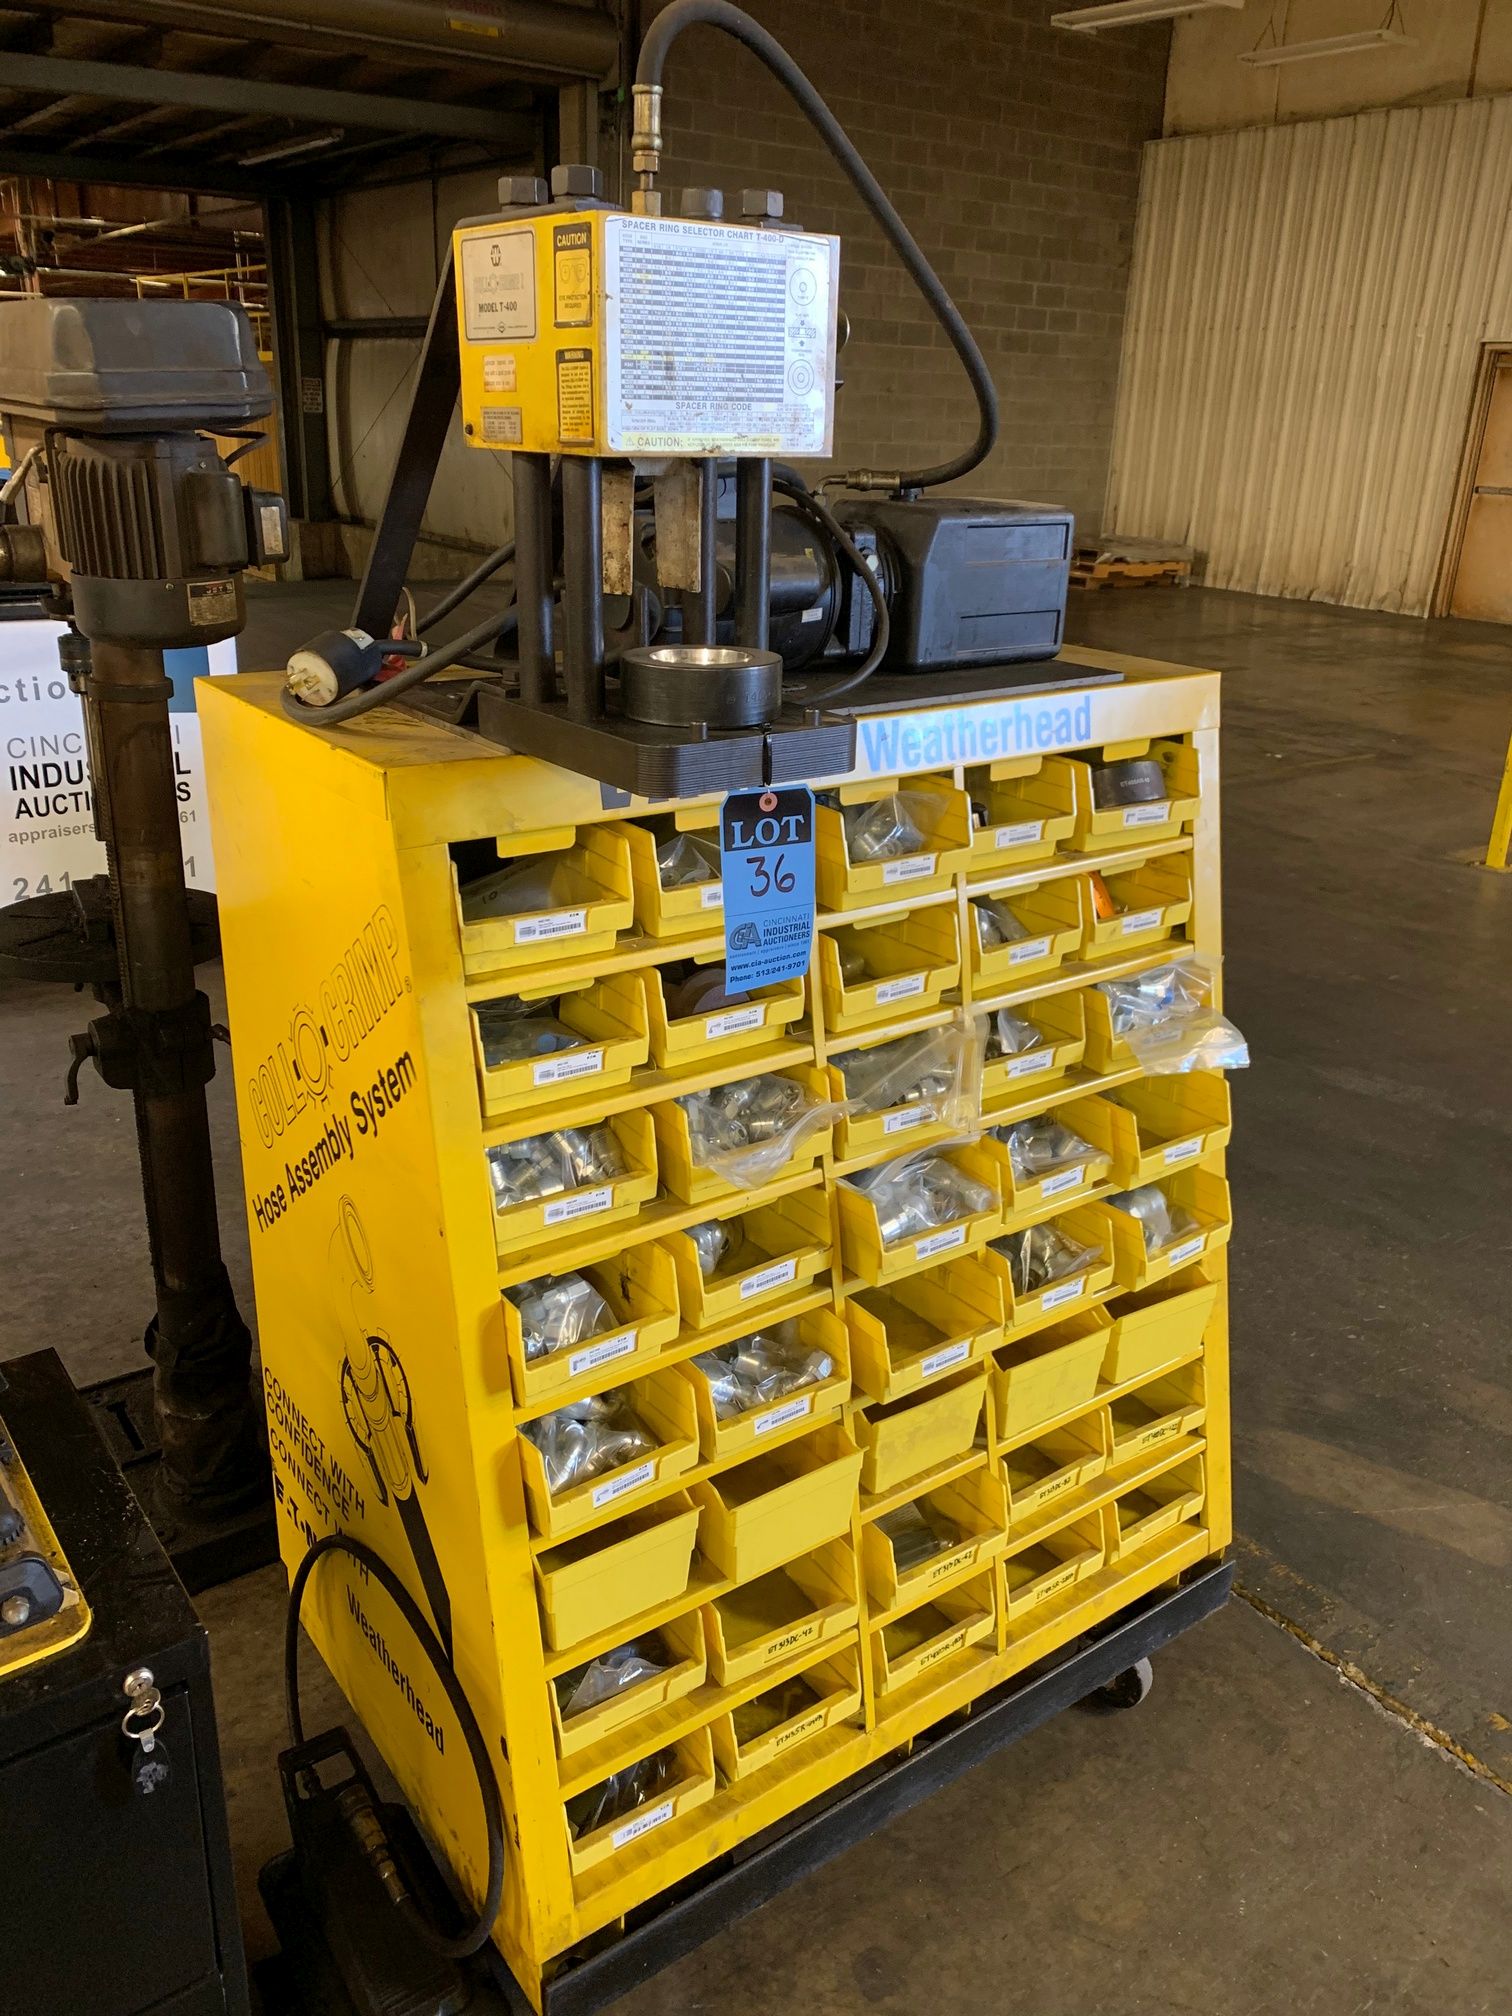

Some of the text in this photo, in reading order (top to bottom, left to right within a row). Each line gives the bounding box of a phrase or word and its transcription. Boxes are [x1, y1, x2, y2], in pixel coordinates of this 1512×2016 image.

[557, 232, 587, 247] CAUTION
[622, 220, 656, 231] SPACER
[659, 224, 680, 233] RING
[682, 225, 725, 239] SELECTOR
[727, 230, 754, 240] CHART
[478, 301, 517, 313] MODEL T-400
[675, 402, 752, 411] SPACER RING CODE
[637, 437, 683, 447] CAUTION:
[860, 696, 1091, 772] Weatherhead
[731, 815, 805, 849] LOT
[746, 853, 796, 897] 36
[763, 913, 810, 927] CINCINNATI
[763, 922, 811, 937] INDUSTRIAL
[763, 930, 810, 946] AUCTIONEERS
[731, 951, 807, 971] www.cia-auction.com
[730, 973, 754, 983] Phone:
[252, 1050, 418, 1233] Hose Assembly System
[264, 1366, 365, 1520] CONNECT WITH
[265, 1391, 350, 1522] CONFIDENCE
[270, 1426, 330, 1525] CONNECT
[346, 1584, 445, 1756] Weatherhead
